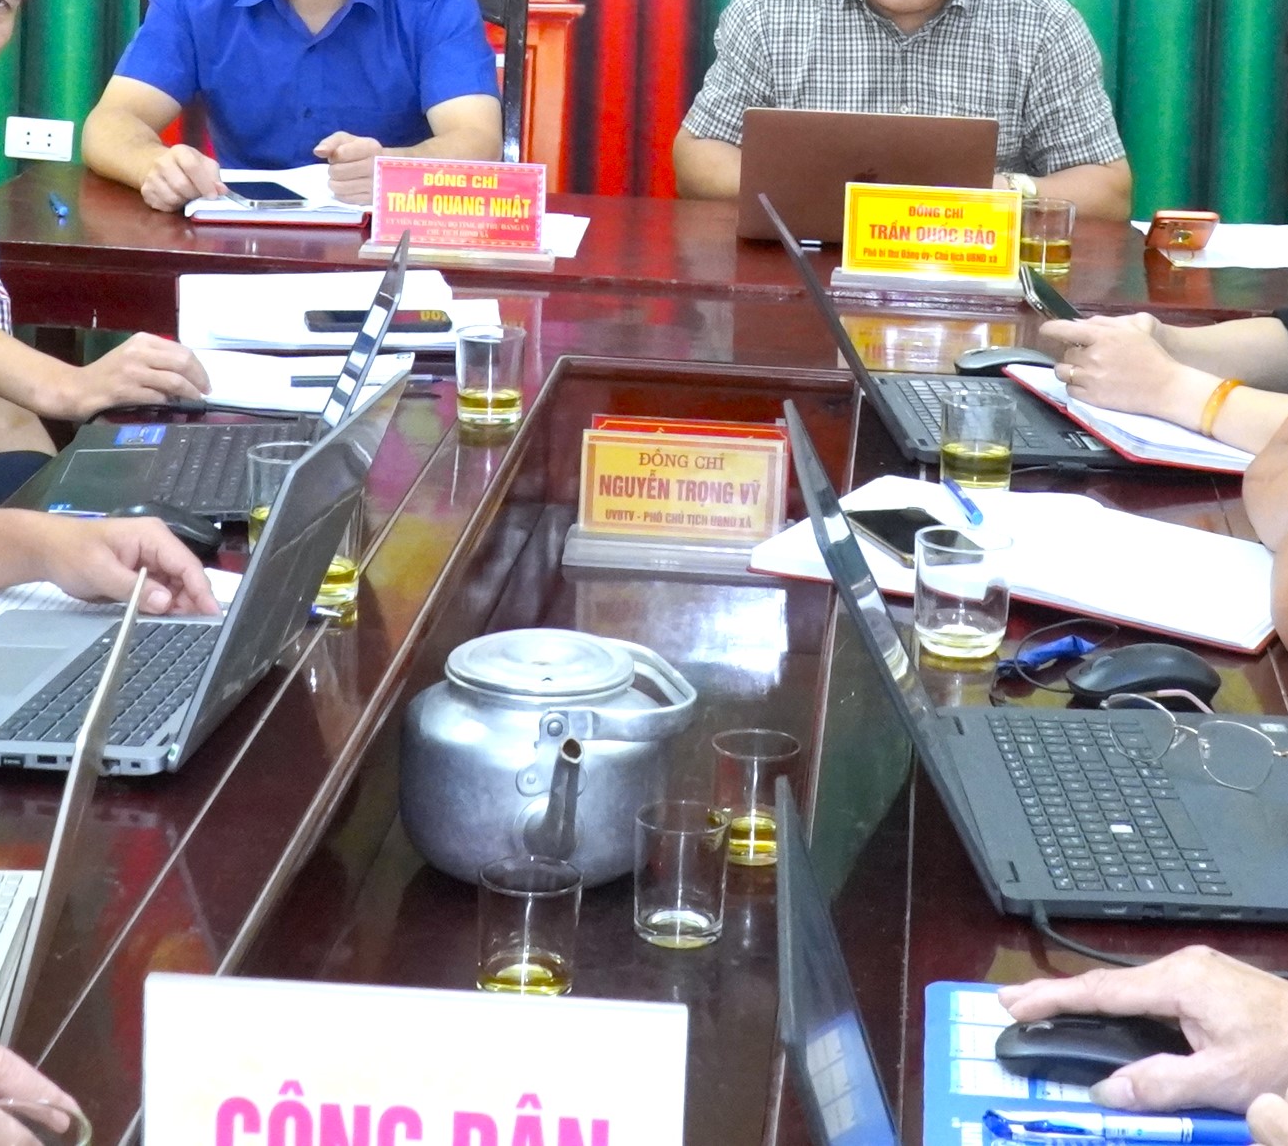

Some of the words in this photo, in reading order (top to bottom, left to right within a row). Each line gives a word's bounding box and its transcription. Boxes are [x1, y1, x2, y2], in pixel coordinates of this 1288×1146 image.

[423, 170, 467, 188] ĐỒNG
[471, 173, 499, 190] CHÍ
[386, 187, 427, 214] TRẦN
[432, 194, 485, 217] QUANG
[489, 194, 532, 223] NHẬT
[908, 203, 941, 219] ĐỒNG
[944, 206, 964, 220] CHÍ
[869, 220, 911, 241] TRẦN
[916, 222, 959, 243] QUỐC
[963, 225, 996, 246] BẢO
[639, 448, 689, 468] ĐỒNG
[695, 452, 725, 471] CHÍ
[599, 469, 671, 501] NGUYỄN
[675, 479, 734, 508] TRỌNG
[739, 479, 762, 506] VỸ
